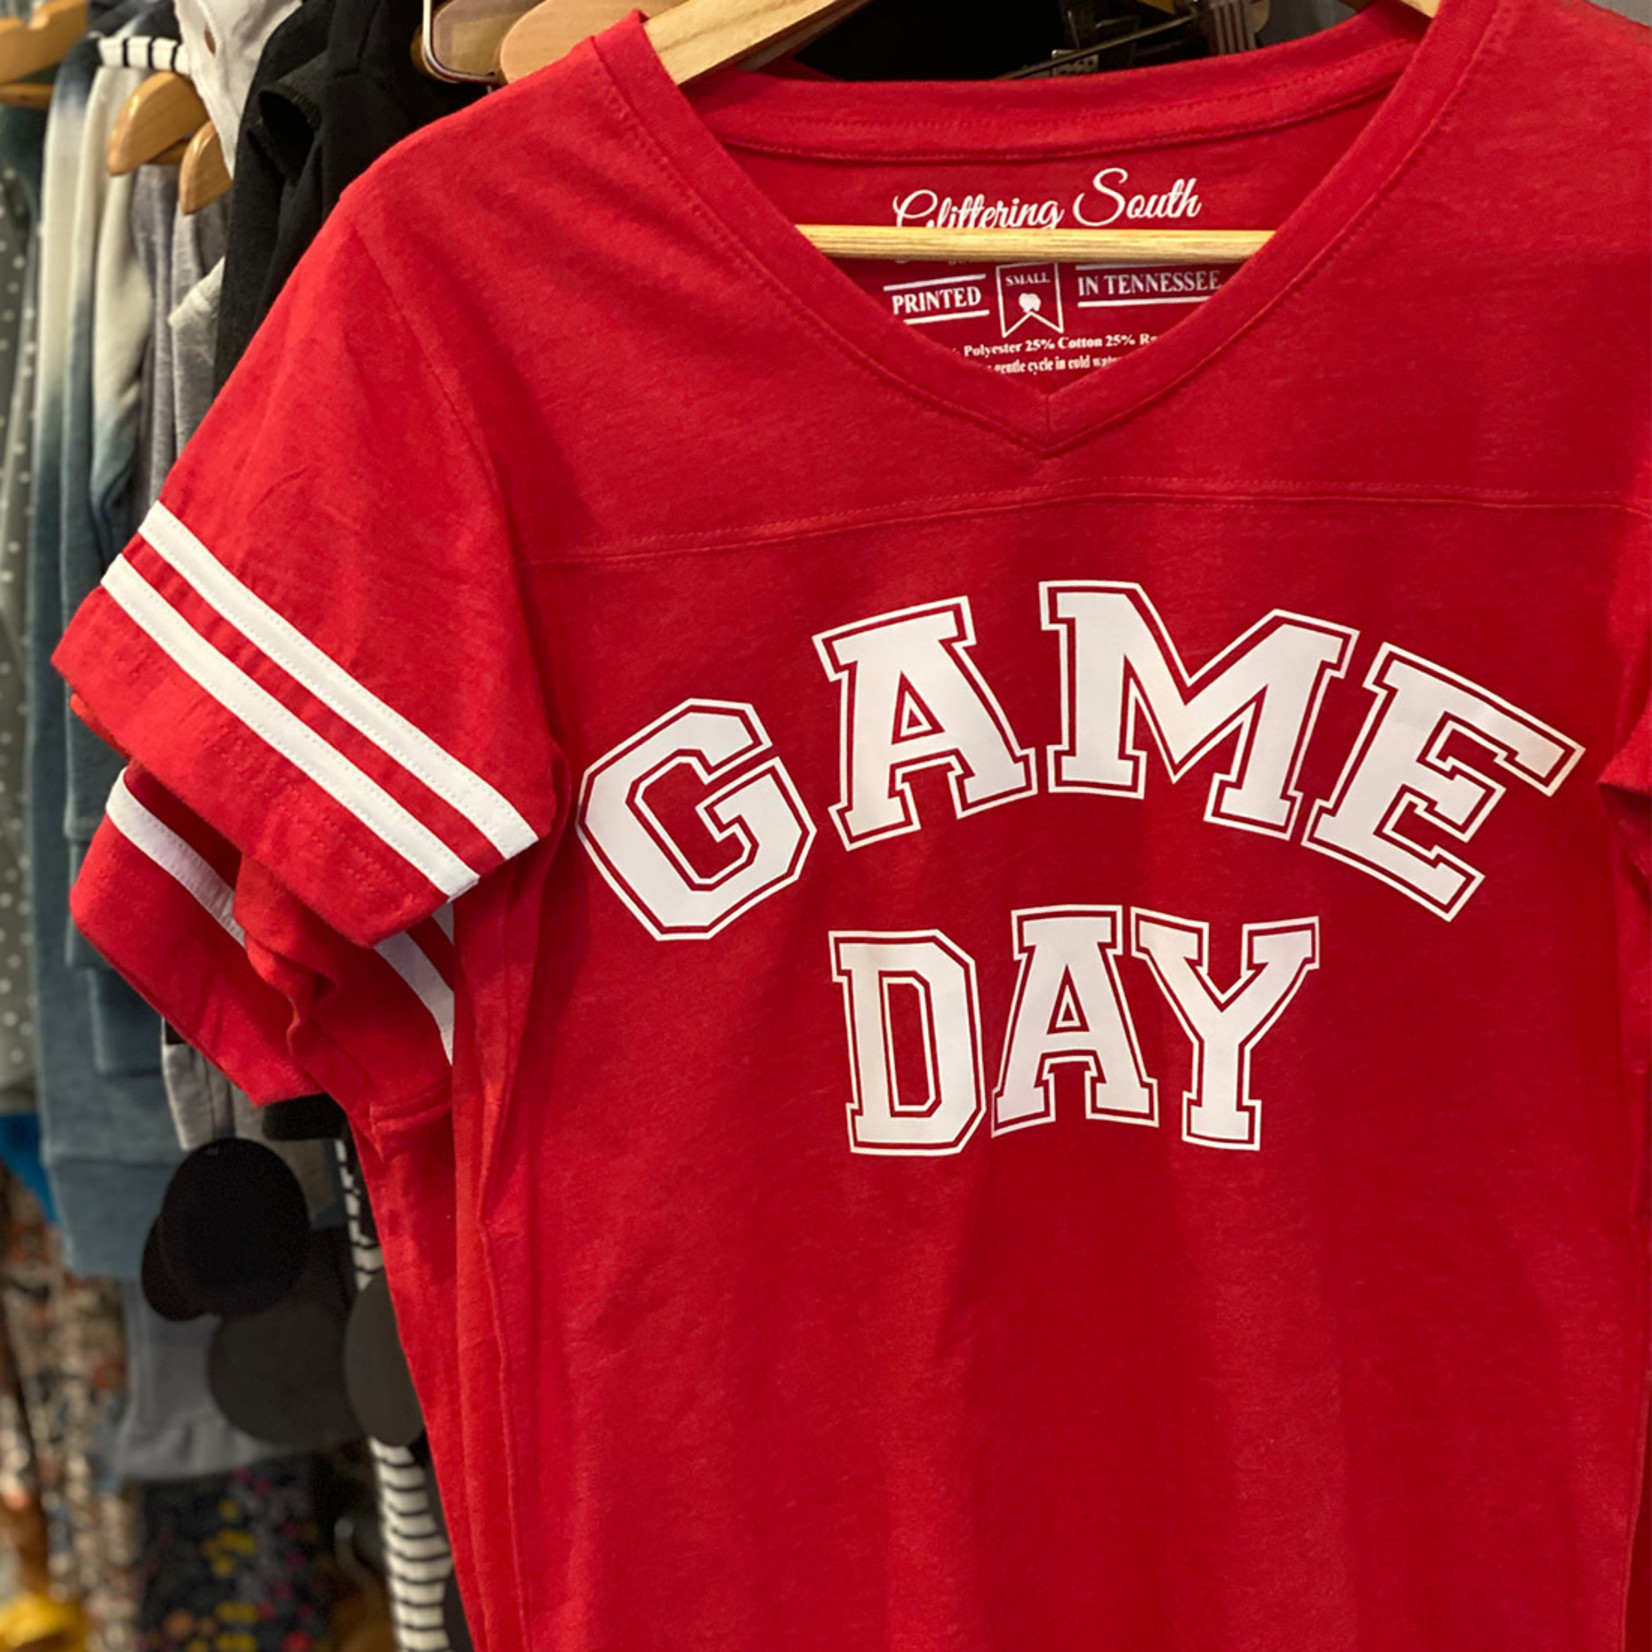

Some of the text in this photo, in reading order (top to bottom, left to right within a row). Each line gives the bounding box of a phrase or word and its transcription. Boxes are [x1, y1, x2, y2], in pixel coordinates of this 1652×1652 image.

[1073, 167, 1202, 227] South
[892, 270, 1222, 315] PRINTED IN TENNESSEE
[1005, 272, 1051, 287] SMALL
[963, 343, 1022, 359] Polyester
[1025, 339, 1055, 352] 25%
[1057, 336, 1102, 349] Cotton
[1105, 334, 1136, 347] 25%
[1027, 357, 1054, 375] cycle
[1055, 355, 1066, 370] in
[1068, 354, 1091, 369] cold
[576, 579, 1585, 942] GAME
[829, 904, 1319, 1157] DAY
